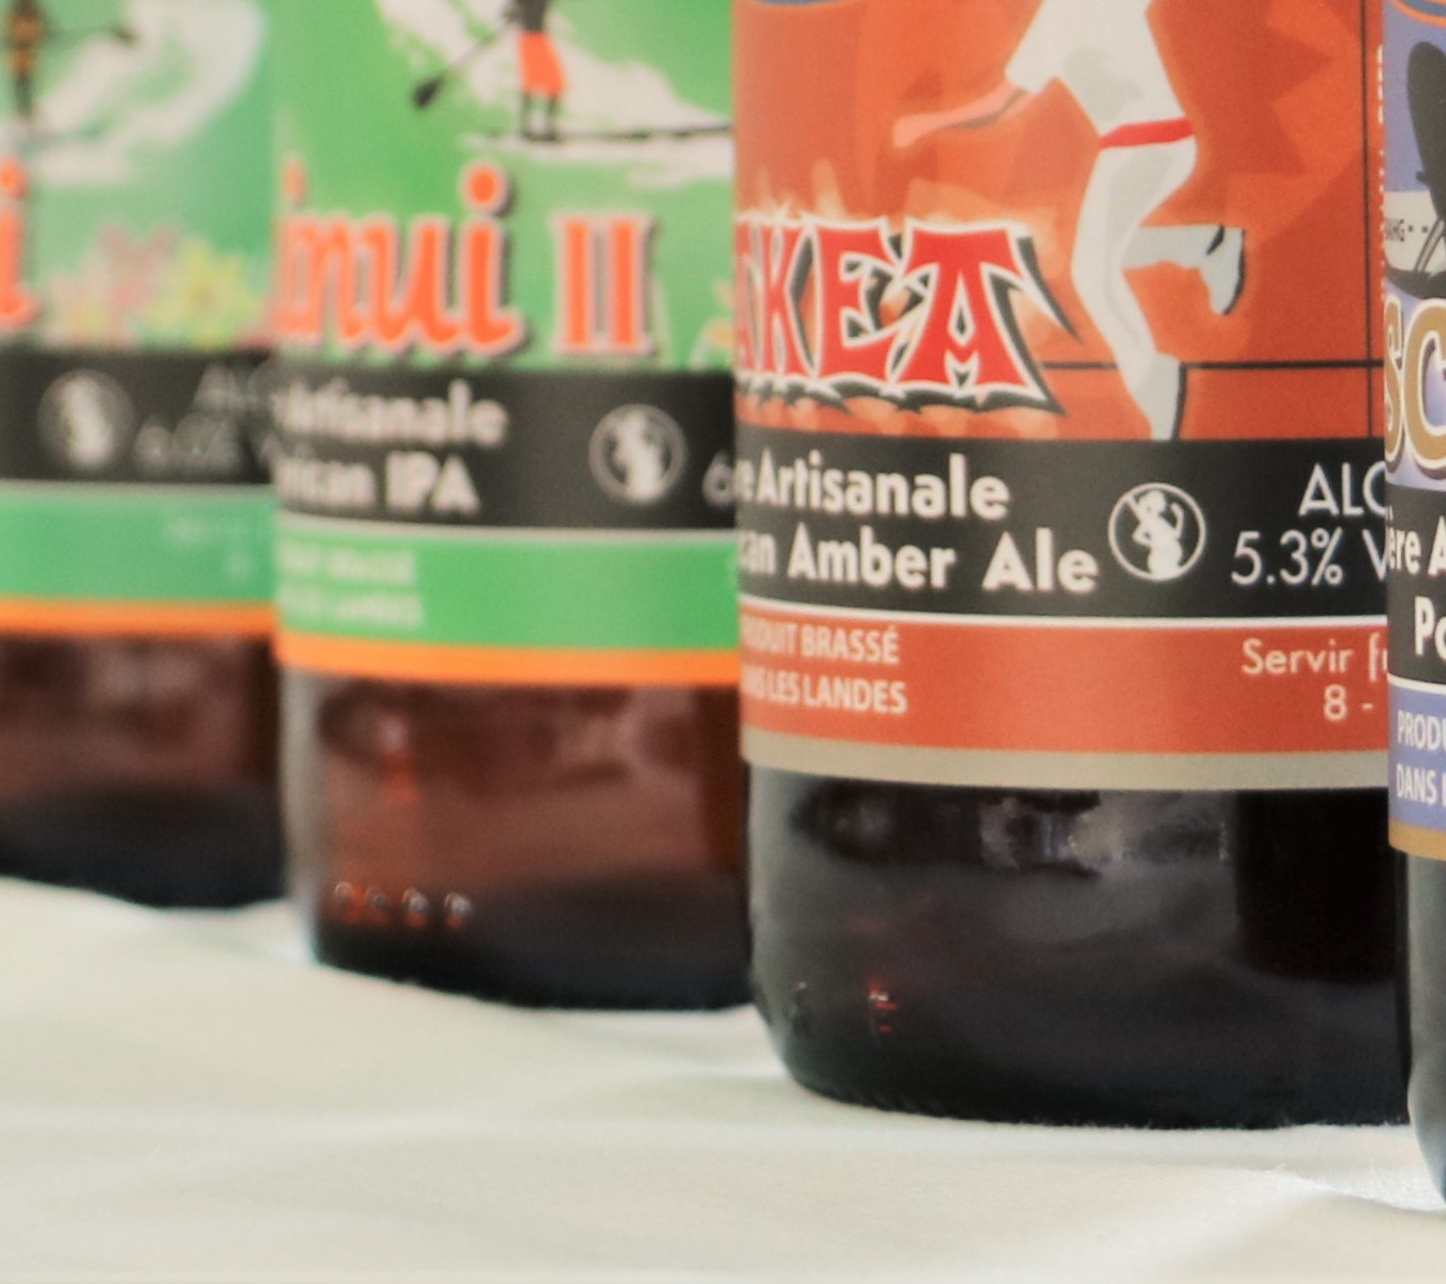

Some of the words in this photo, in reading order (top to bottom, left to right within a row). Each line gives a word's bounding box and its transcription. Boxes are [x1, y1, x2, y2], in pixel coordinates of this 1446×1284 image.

[384, 449, 481, 518] IPA
[758, 446, 1011, 519] Artisanale
[786, 521, 956, 589] Amber
[981, 526, 1100, 593] Ale
[1230, 526, 1344, 585] 5.3%
[800, 621, 901, 666] BRASSÉ
[1241, 637, 1354, 677] Servir
[768, 667, 800, 706] LES
[802, 673, 909, 716] LANDES
[1323, 683, 1348, 722] 8
[1395, 762, 1438, 806] DANS
